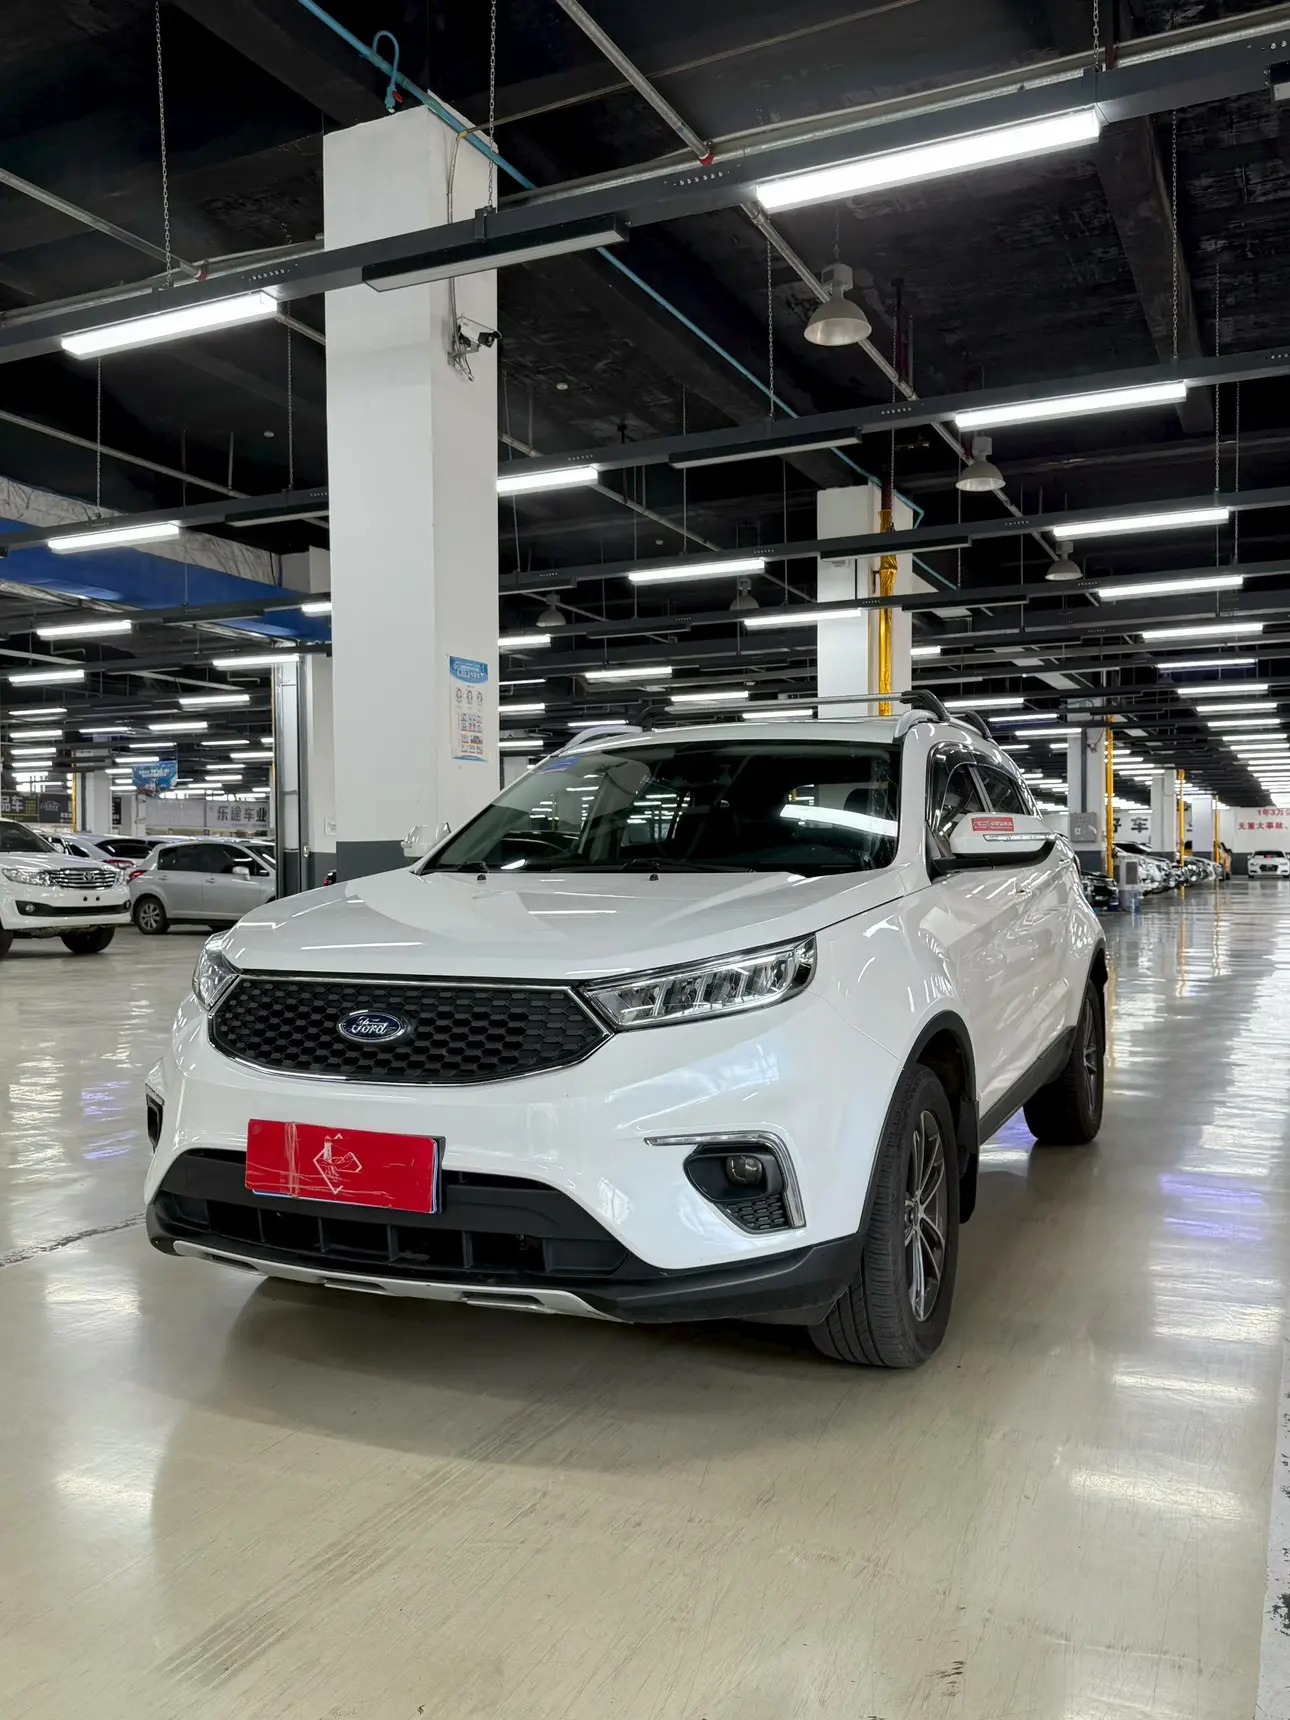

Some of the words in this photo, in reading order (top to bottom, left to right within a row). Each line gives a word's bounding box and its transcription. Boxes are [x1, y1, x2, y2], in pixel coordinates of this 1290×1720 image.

[217, 806, 267, 822] 乐途车业
[351, 1016, 389, 1035] Ford
